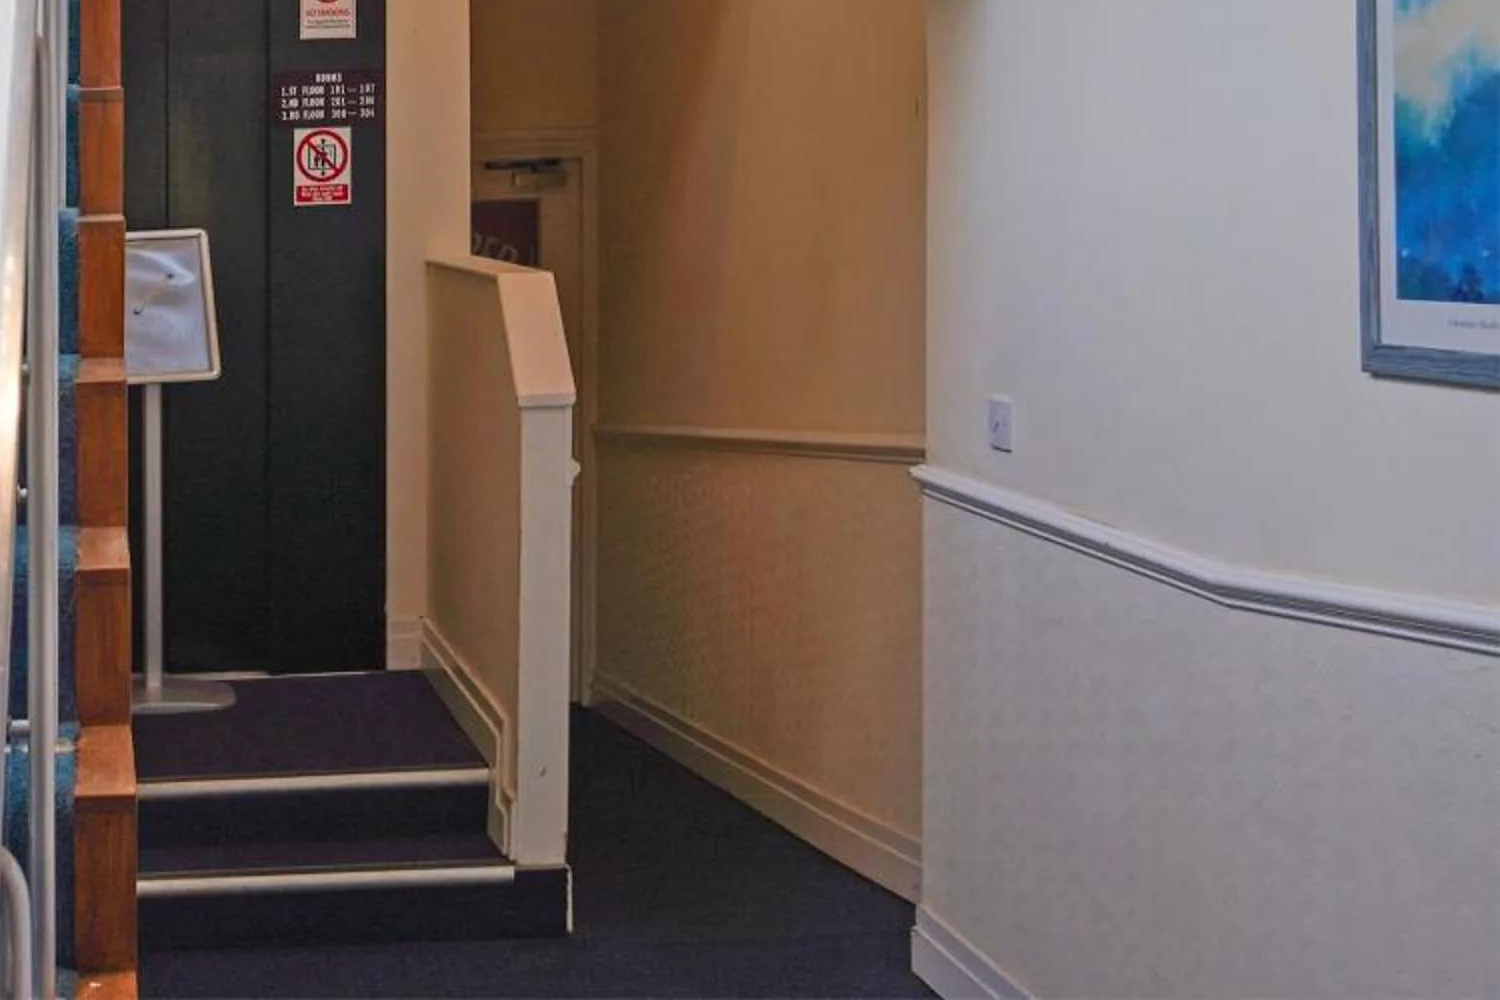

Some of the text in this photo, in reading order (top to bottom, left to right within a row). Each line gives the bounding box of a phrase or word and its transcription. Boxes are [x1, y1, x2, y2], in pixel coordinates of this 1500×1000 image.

[301, 85, 325, 95] FLOOR
[301, 96, 325, 107] FLOOR
[302, 109, 325, 119] FLOOR
